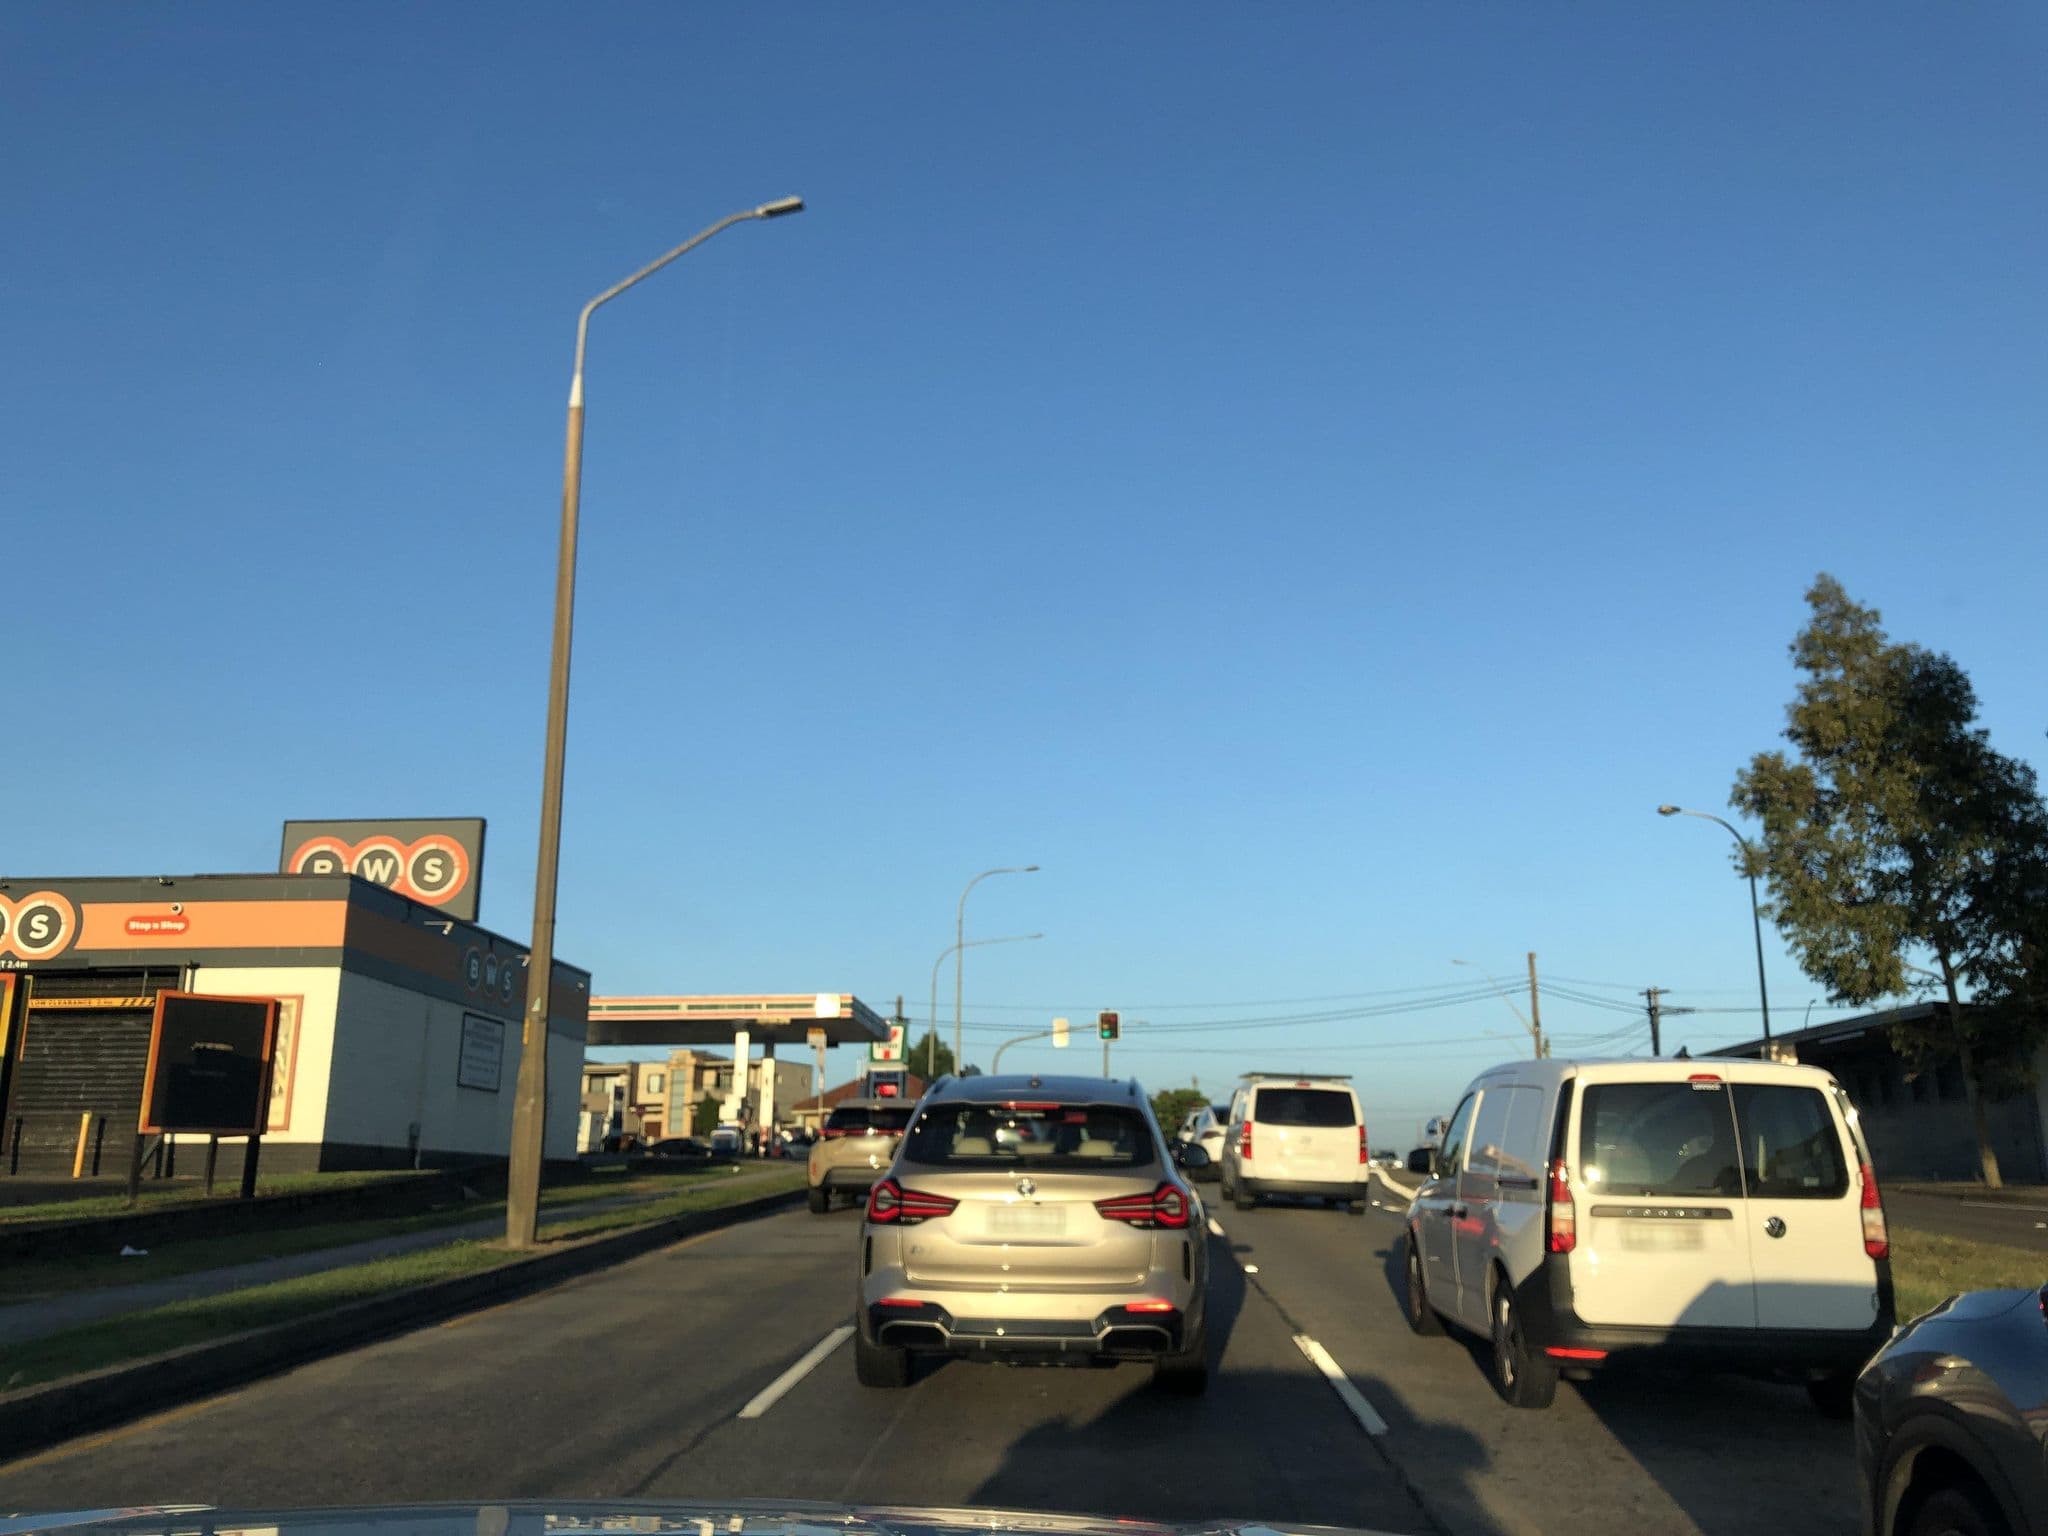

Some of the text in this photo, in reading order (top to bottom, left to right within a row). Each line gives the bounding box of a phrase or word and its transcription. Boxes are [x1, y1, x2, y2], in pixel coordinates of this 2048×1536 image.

[129, 920, 186, 932] Stop n Shop
